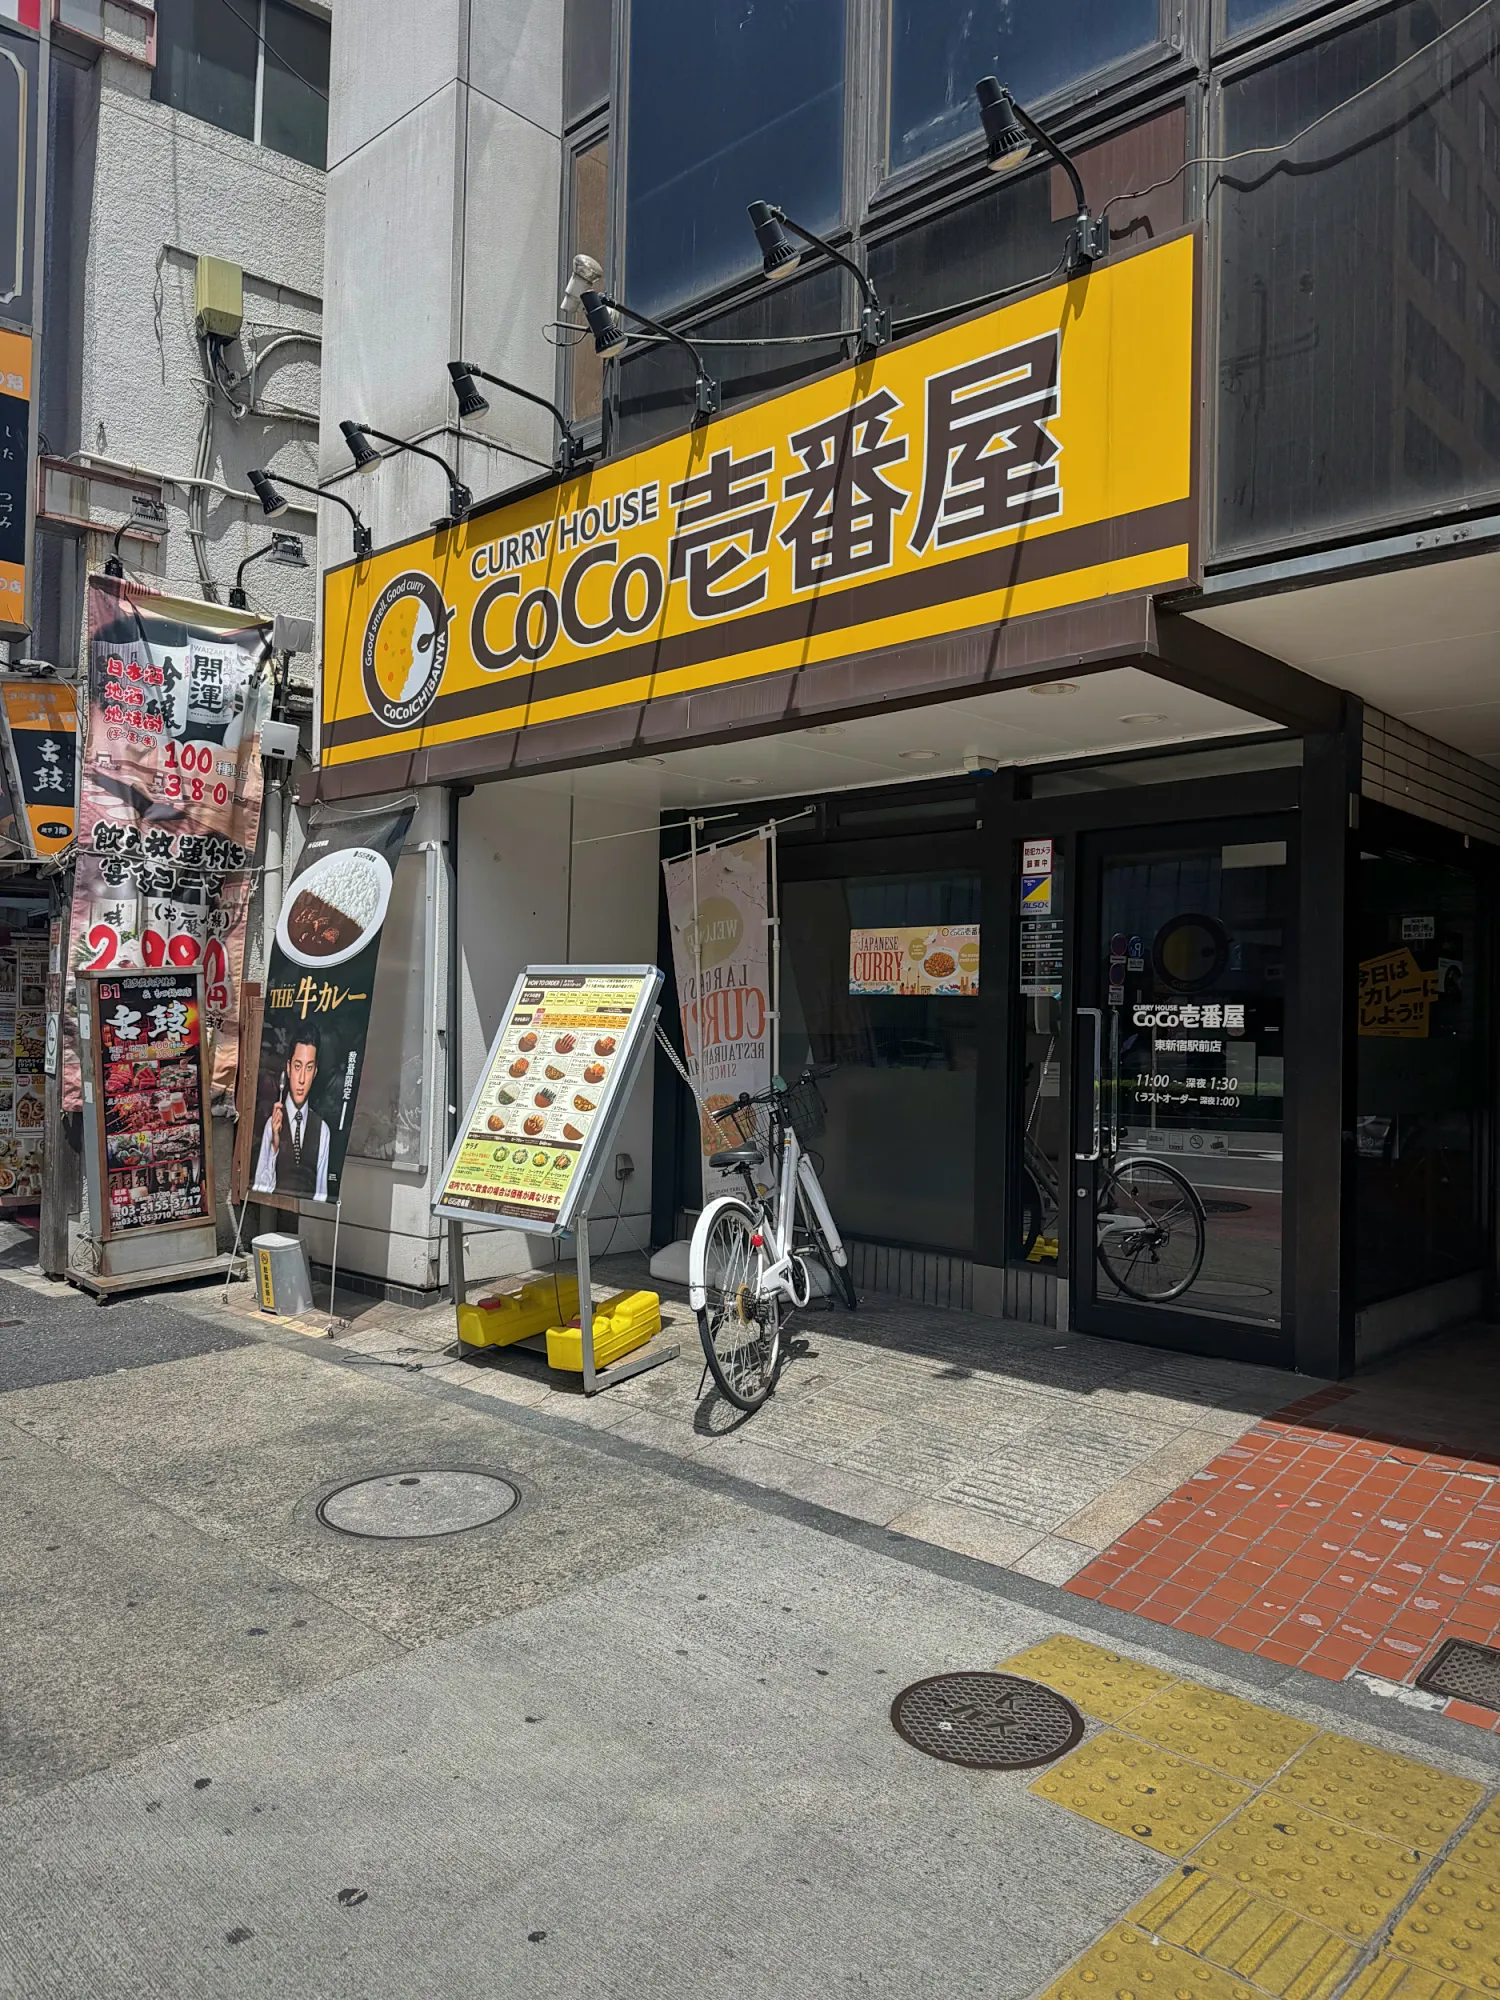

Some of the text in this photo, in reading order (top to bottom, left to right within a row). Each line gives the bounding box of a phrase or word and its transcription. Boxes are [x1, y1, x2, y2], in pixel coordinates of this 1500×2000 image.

[470, 480, 660, 581] CURRY HOUSE
[365, 632, 375, 666] Good
[386, 579, 406, 603] Good
[406, 580, 425, 595] curry
[106, 657, 165, 687] 日本酒
[189, 655, 224, 715] 開運
[104, 681, 146, 707] 地酒
[104, 705, 164, 734] 地焼酎
[32, 738, 67, 793] 舌鼓
[94, 821, 246, 869] 飲み放題付き
[1024, 846, 1050, 856] 防犯カメラ
[1022, 901, 1049, 909] ALSOK
[859, 936, 899, 951] JAPANESE
[853, 951, 904, 982] CURRY
[100, 983, 120, 999] B1
[105, 1000, 191, 1040] 舌鼓
[1154, 1039, 1222, 1053] 東新宿駅前店
[1136, 1073, 1169, 1087] 11:00
[1185, 1077, 1207, 1089] 深夜
[1210, 1076, 1238, 1091] 1:30
[121, 1194, 202, 1217] 03-5155-3717
